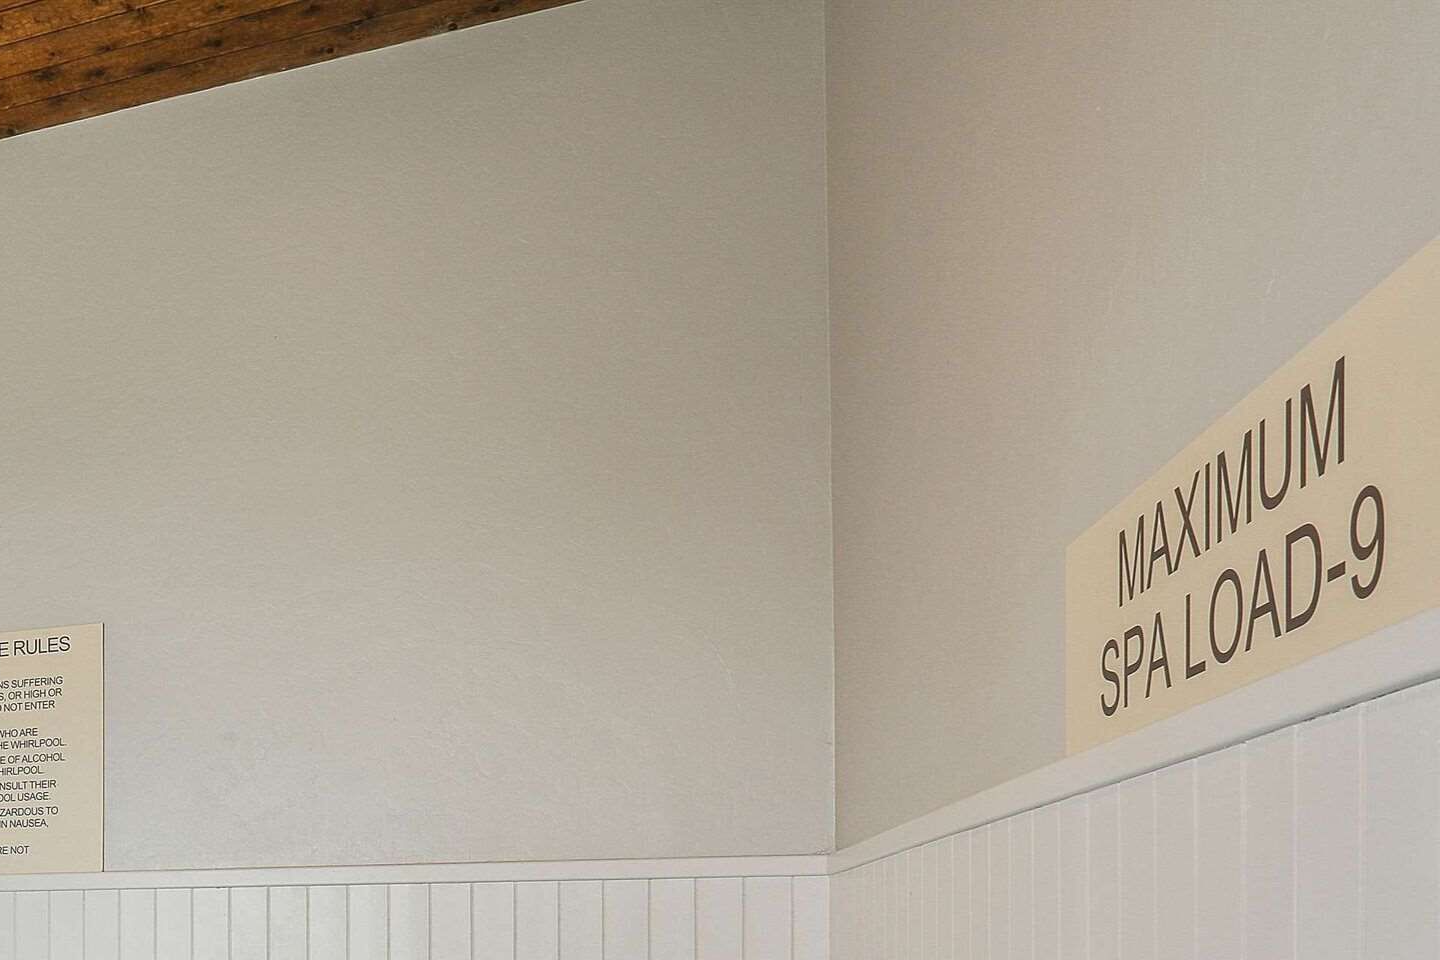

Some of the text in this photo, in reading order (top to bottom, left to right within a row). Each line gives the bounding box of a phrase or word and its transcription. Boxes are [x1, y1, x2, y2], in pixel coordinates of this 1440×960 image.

[1118, 355, 1346, 608] MAXIMUM
[1100, 484, 1386, 717] SPA LOAD-9
[13, 635, 71, 656] RULES
[10, 675, 64, 688] SUFFERING
[8, 691, 22, 700] OR
[23, 689, 47, 699] HIGH
[48, 687, 63, 697] OR
[3, 702, 23, 712] NOT
[24, 700, 56, 711] ENTER
[19, 727, 38, 737] ARE
[7, 755, 20, 764] OF
[21, 753, 65, 763] ALCOHOL
[29, 779, 57, 789] THEIR
[17, 791, 51, 802] USAGE.
[46, 806, 59, 815] TO
[10, 845, 30, 855] NOT
